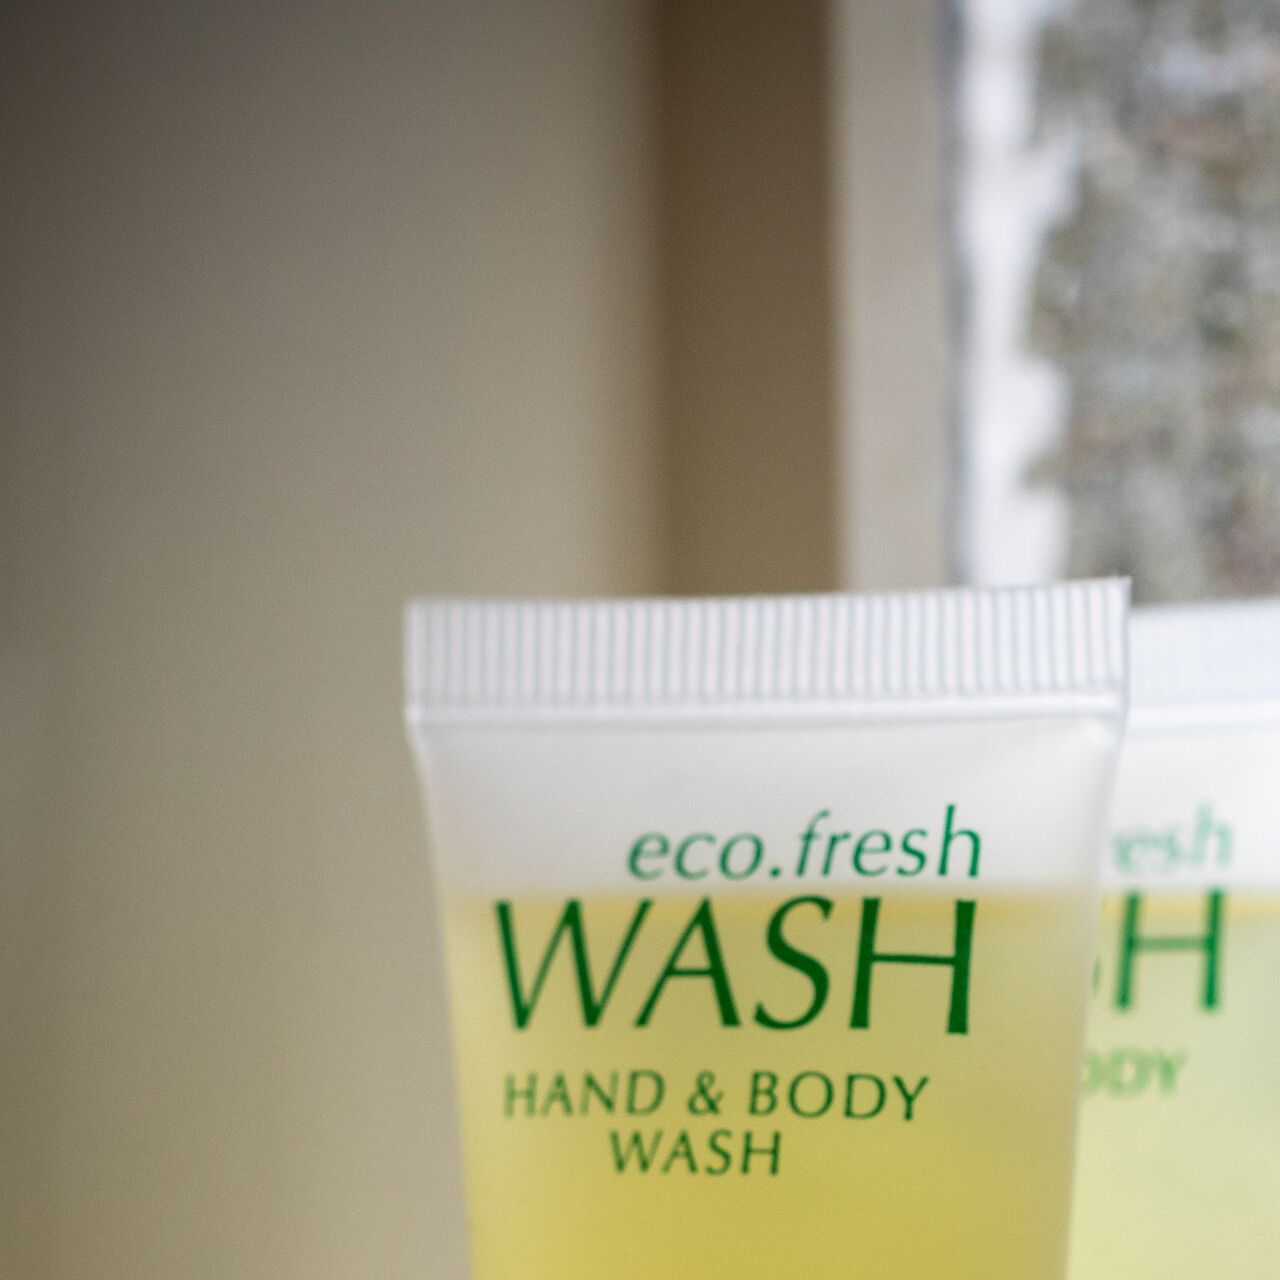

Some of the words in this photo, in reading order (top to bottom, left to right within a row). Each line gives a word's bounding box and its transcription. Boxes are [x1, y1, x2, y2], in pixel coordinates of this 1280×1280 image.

[626, 804, 983, 880] eco.fresh
[494, 895, 976, 1035] WASH
[503, 1070, 666, 1119] HAND
[688, 1070, 724, 1116] &
[748, 1070, 930, 1121] BODY
[607, 1128, 783, 1176] WASH
